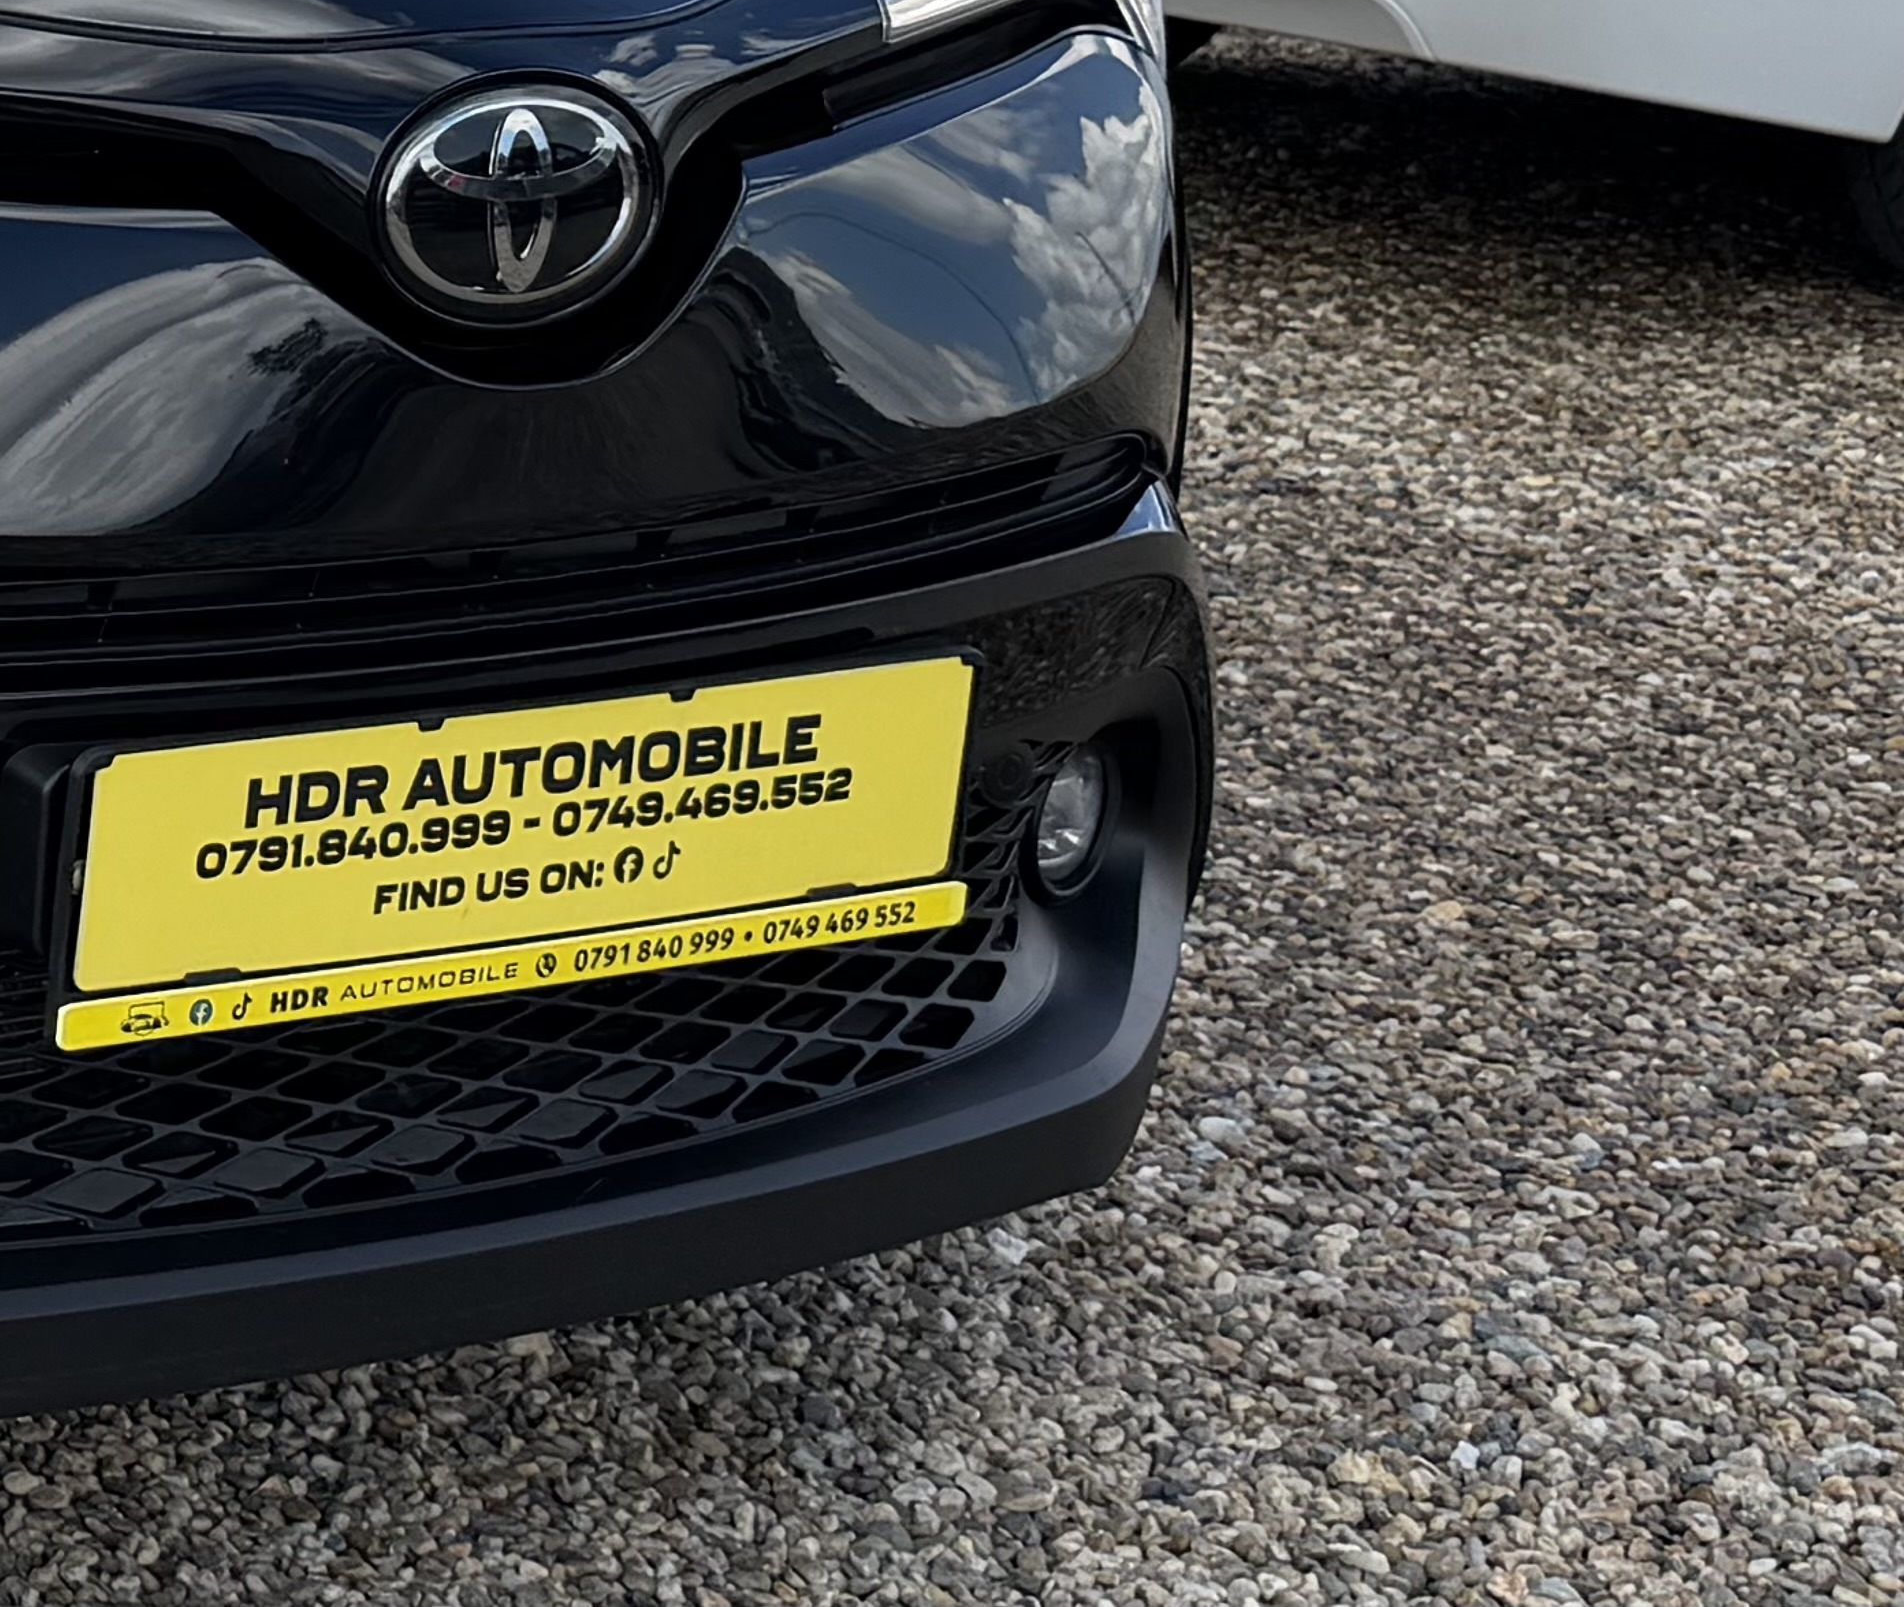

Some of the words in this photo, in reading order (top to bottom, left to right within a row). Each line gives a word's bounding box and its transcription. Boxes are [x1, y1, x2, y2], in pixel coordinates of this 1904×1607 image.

[196, 810, 511, 879] 0791.840.999
[553, 767, 852, 837] 0749.469.552
[244, 764, 389, 829] HDR
[402, 714, 823, 811] AUTOMOBILE
[373, 876, 465, 915] FIND
[476, 867, 530, 902] US
[540, 857, 604, 894] ON:
[270, 986, 329, 1013] HDR
[340, 962, 519, 1001] AUTOMOBILE
[574, 943, 630, 972] 0791
[636, 935, 683, 963] 840
[690, 927, 735, 955] 999
[763, 915, 820, 944] 0749
[825, 908, 869, 934] 469
[875, 901, 915, 928] 552
